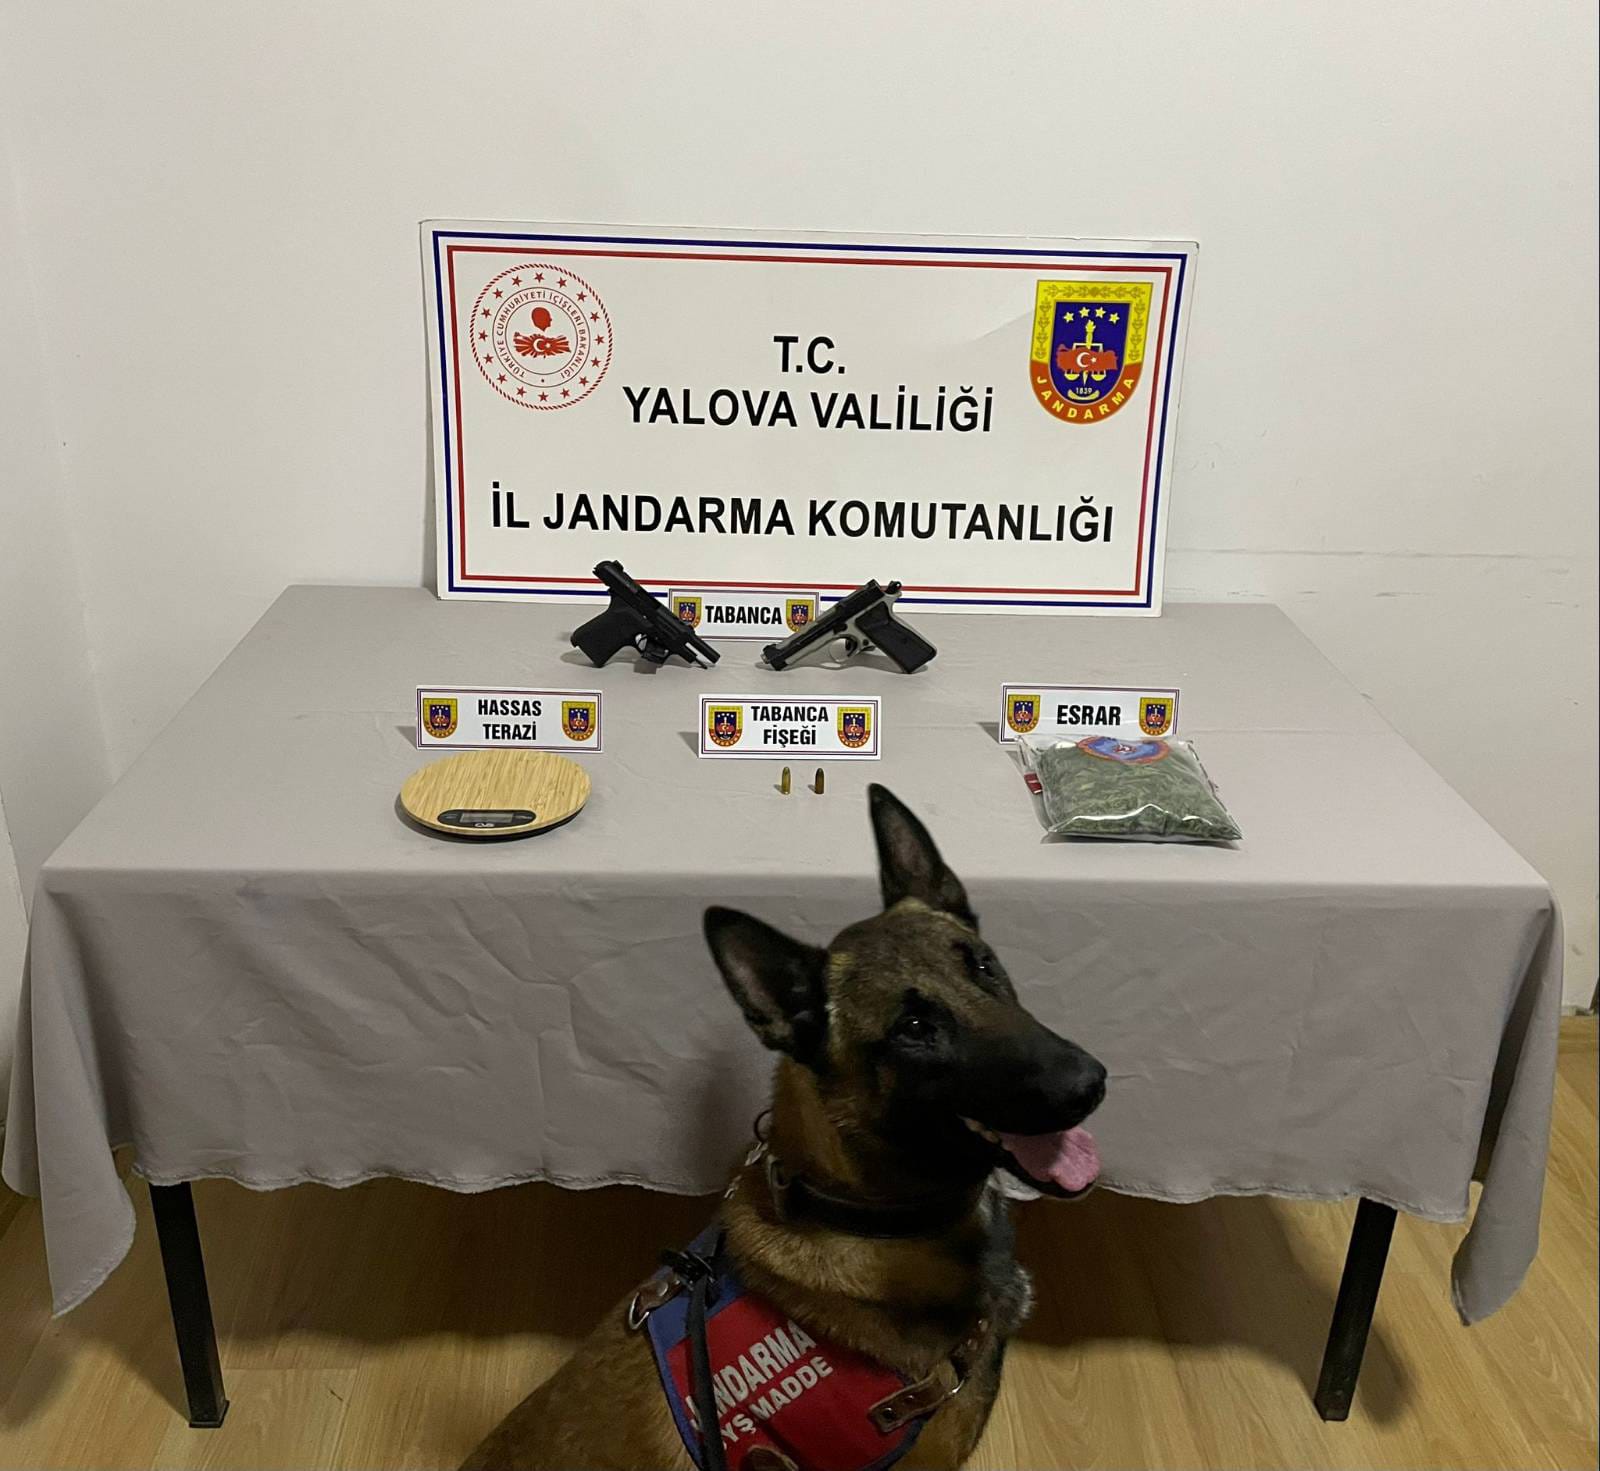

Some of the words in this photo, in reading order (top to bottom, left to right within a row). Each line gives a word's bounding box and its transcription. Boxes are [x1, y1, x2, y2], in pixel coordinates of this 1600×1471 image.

[496, 291, 546, 336] CUMHURİYETİ
[549, 292, 585, 326] İÇİŞLERİ
[560, 328, 587, 379] BAKANLIĞI
[773, 335, 845, 375] T.C.
[622, 386, 798, 428] YALOVA
[810, 384, 993, 432] VALİLİĞİ
[1036, 375, 1135, 420] JANDARMA
[492, 481, 530, 529] İL
[543, 492, 795, 536] JANDARMA
[808, 495, 1113, 543] KOMUTANLIĞI
[705, 605, 783, 625] TABANCA
[478, 699, 542, 717] HASSAS
[751, 705, 829, 722] TABANCA
[1056, 704, 1121, 726] ESRAR
[482, 720, 537, 741] TERAZİ
[763, 724, 817, 748] FİŞEĞİ
[685, 1320, 817, 1432] JNDARMA
[720, 1413, 757, 1451] YŞ
[749, 1356, 834, 1421] MADDE
